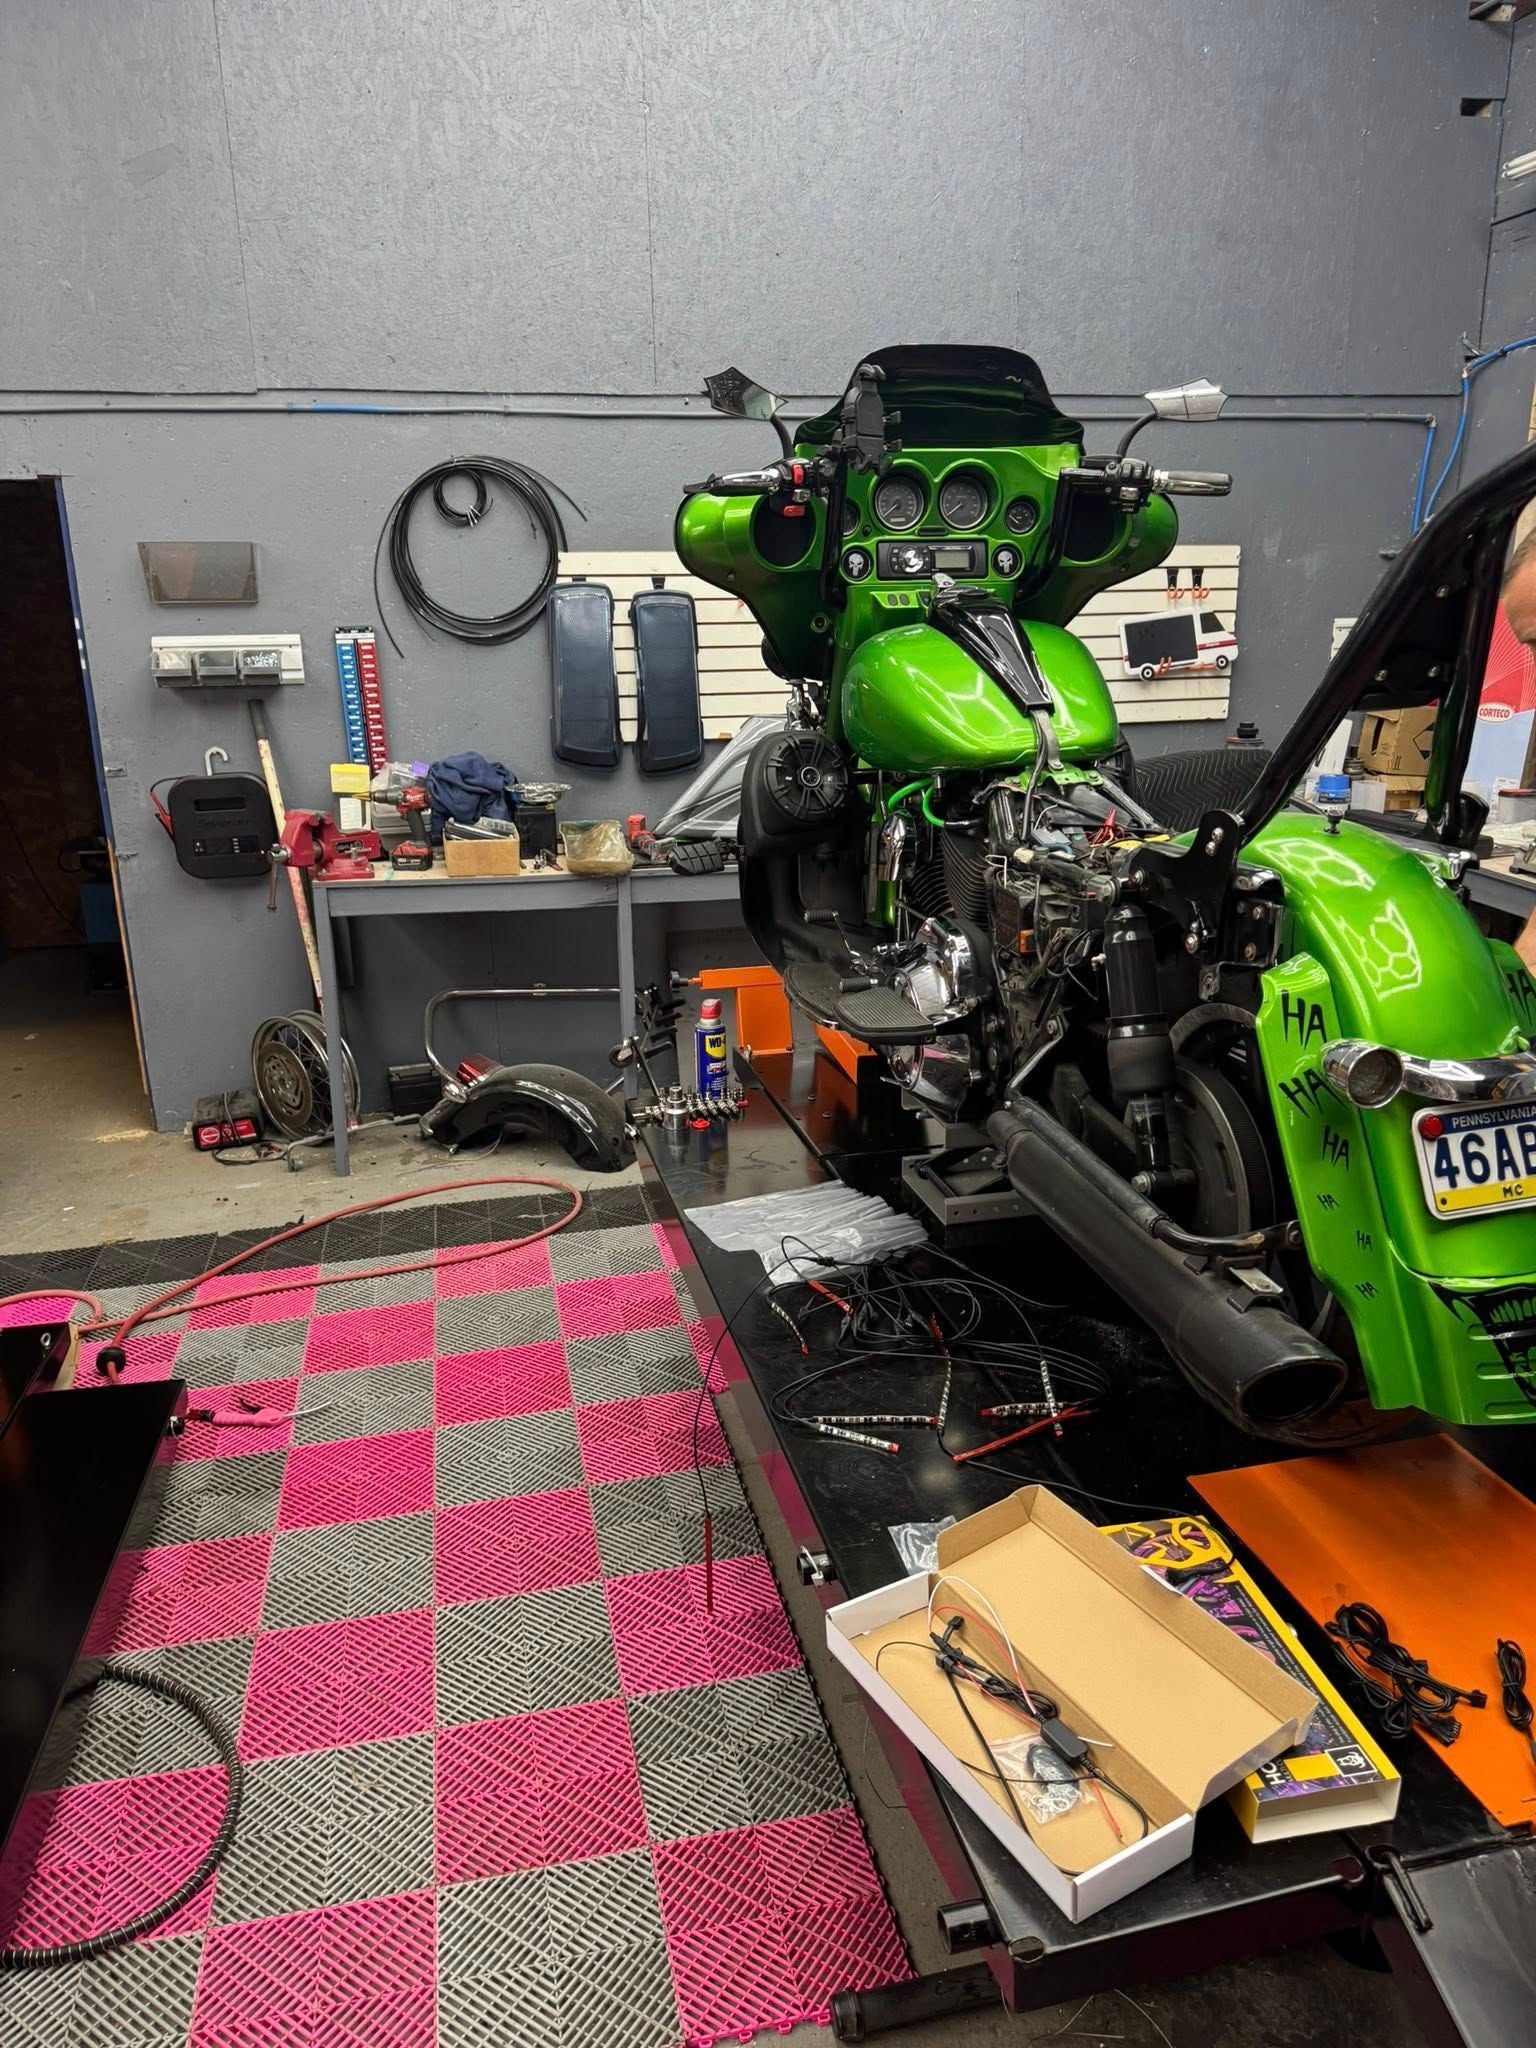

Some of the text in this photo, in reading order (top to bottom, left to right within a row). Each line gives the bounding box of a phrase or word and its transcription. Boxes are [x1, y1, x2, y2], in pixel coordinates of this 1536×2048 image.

[1479, 707, 1511, 719] CORTECO
[1280, 989, 1328, 1051] HA
[1278, 1068, 1348, 1120] HA
[1452, 1106, 1536, 1129] PENNSYLVANIA
[1321, 1124, 1350, 1173] HA
[1434, 1124, 1536, 1189] 46AB
[1316, 1193, 1341, 1212] HA
[1502, 1183, 1524, 1199] MC
[1356, 1229, 1373, 1252] HA
[1355, 1281, 1381, 1301] HA
